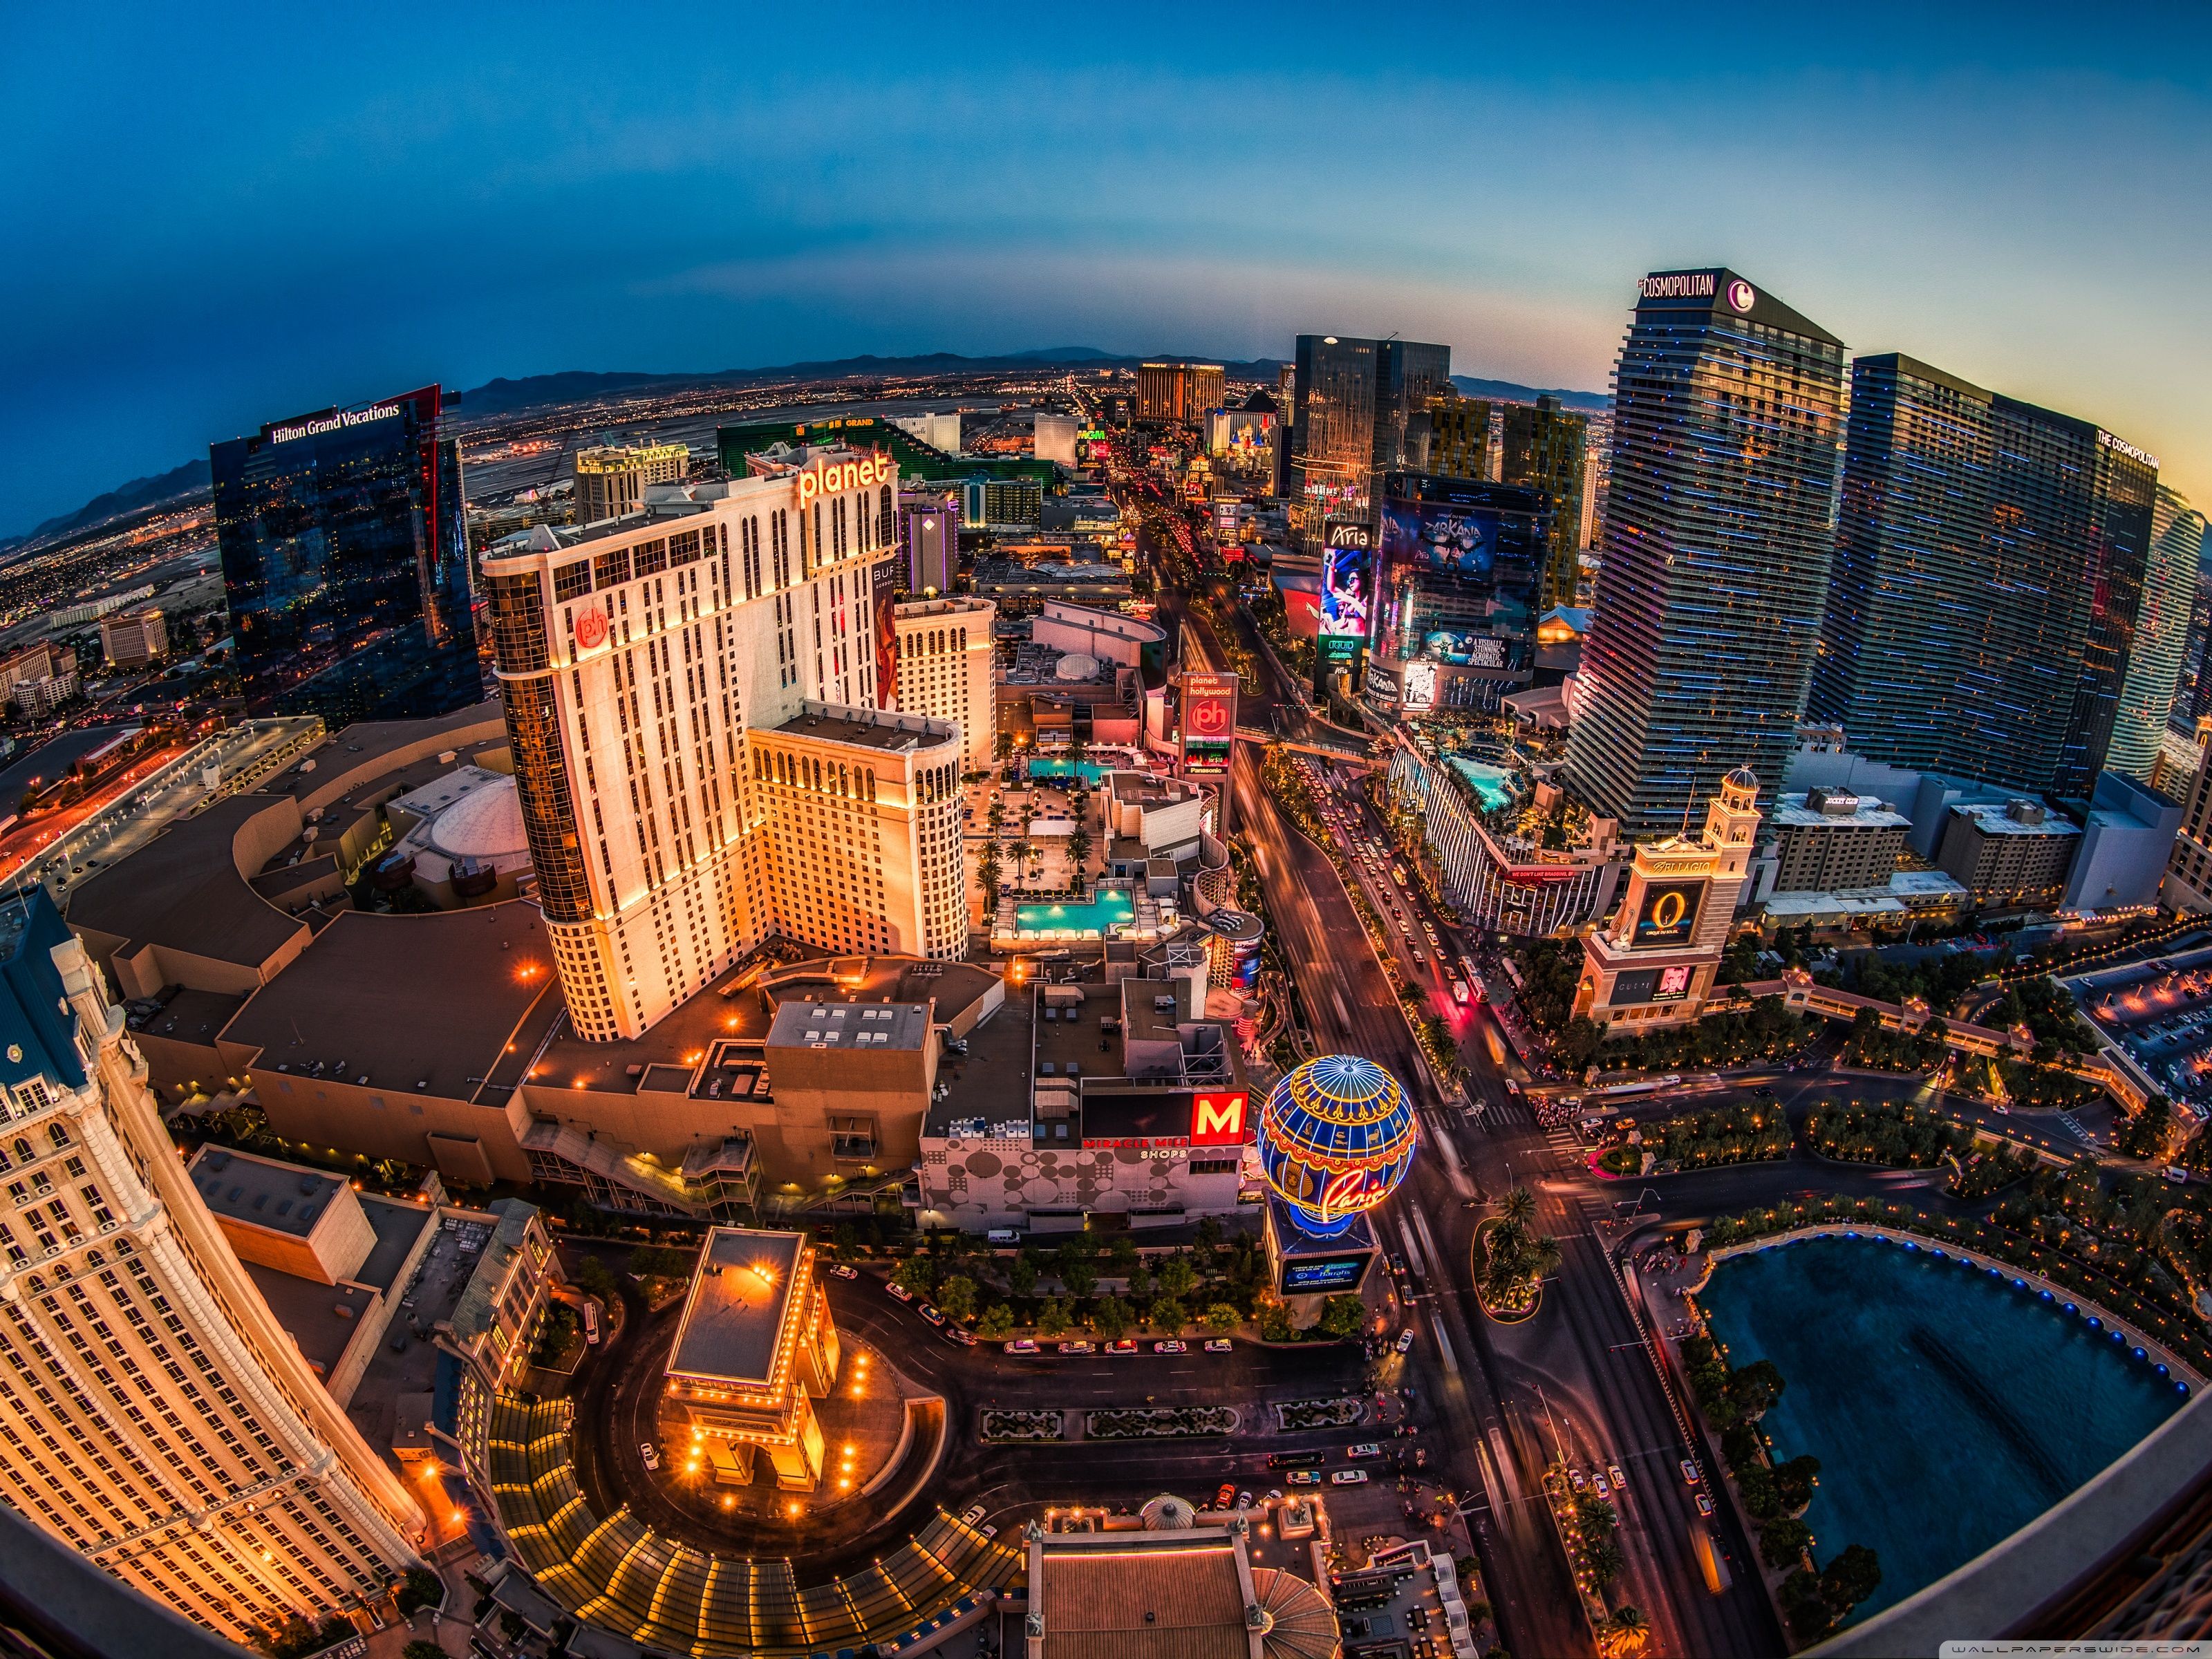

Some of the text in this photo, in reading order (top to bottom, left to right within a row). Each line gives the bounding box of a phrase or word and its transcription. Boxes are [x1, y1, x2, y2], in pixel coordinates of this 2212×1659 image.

[1644, 274, 1714, 297] COSMOPOLITAN
[272, 404, 400, 444] Hilton Grand Vacations
[845, 418, 874, 427] GRAND
[1077, 430, 1105, 440] MGM
[2097, 430, 2159, 469] THE COSMOPOLITAN
[799, 452, 888, 509] planet
[1425, 519, 1482, 538] ZARKANA
[1331, 526, 1368, 546] Aria
[1414, 550, 1430, 559] Aria
[577, 608, 608, 648] ph
[1329, 641, 1353, 649] LIQUID
[1479, 639, 1503, 648] VISUALLY
[1474, 645, 1500, 654] STUNNING
[1472, 651, 1501, 661] ACROBATIC
[1468, 657, 1503, 668] SPECTACULAR
[1190, 676, 1218, 686] planet
[1190, 686, 1231, 697] hollywood
[1380, 693, 1398, 702] DISBELIEF
[1194, 700, 1226, 730] ph
[1650, 861, 1710, 873] BELLAGIO
[1652, 892, 1685, 928] O
[1197, 1098, 1243, 1134] M
[1083, 1138, 1188, 1148] MIRACLE MILE
[1141, 1150, 1187, 1159] SHOPS
[1322, 1169, 1386, 1224] Paris
